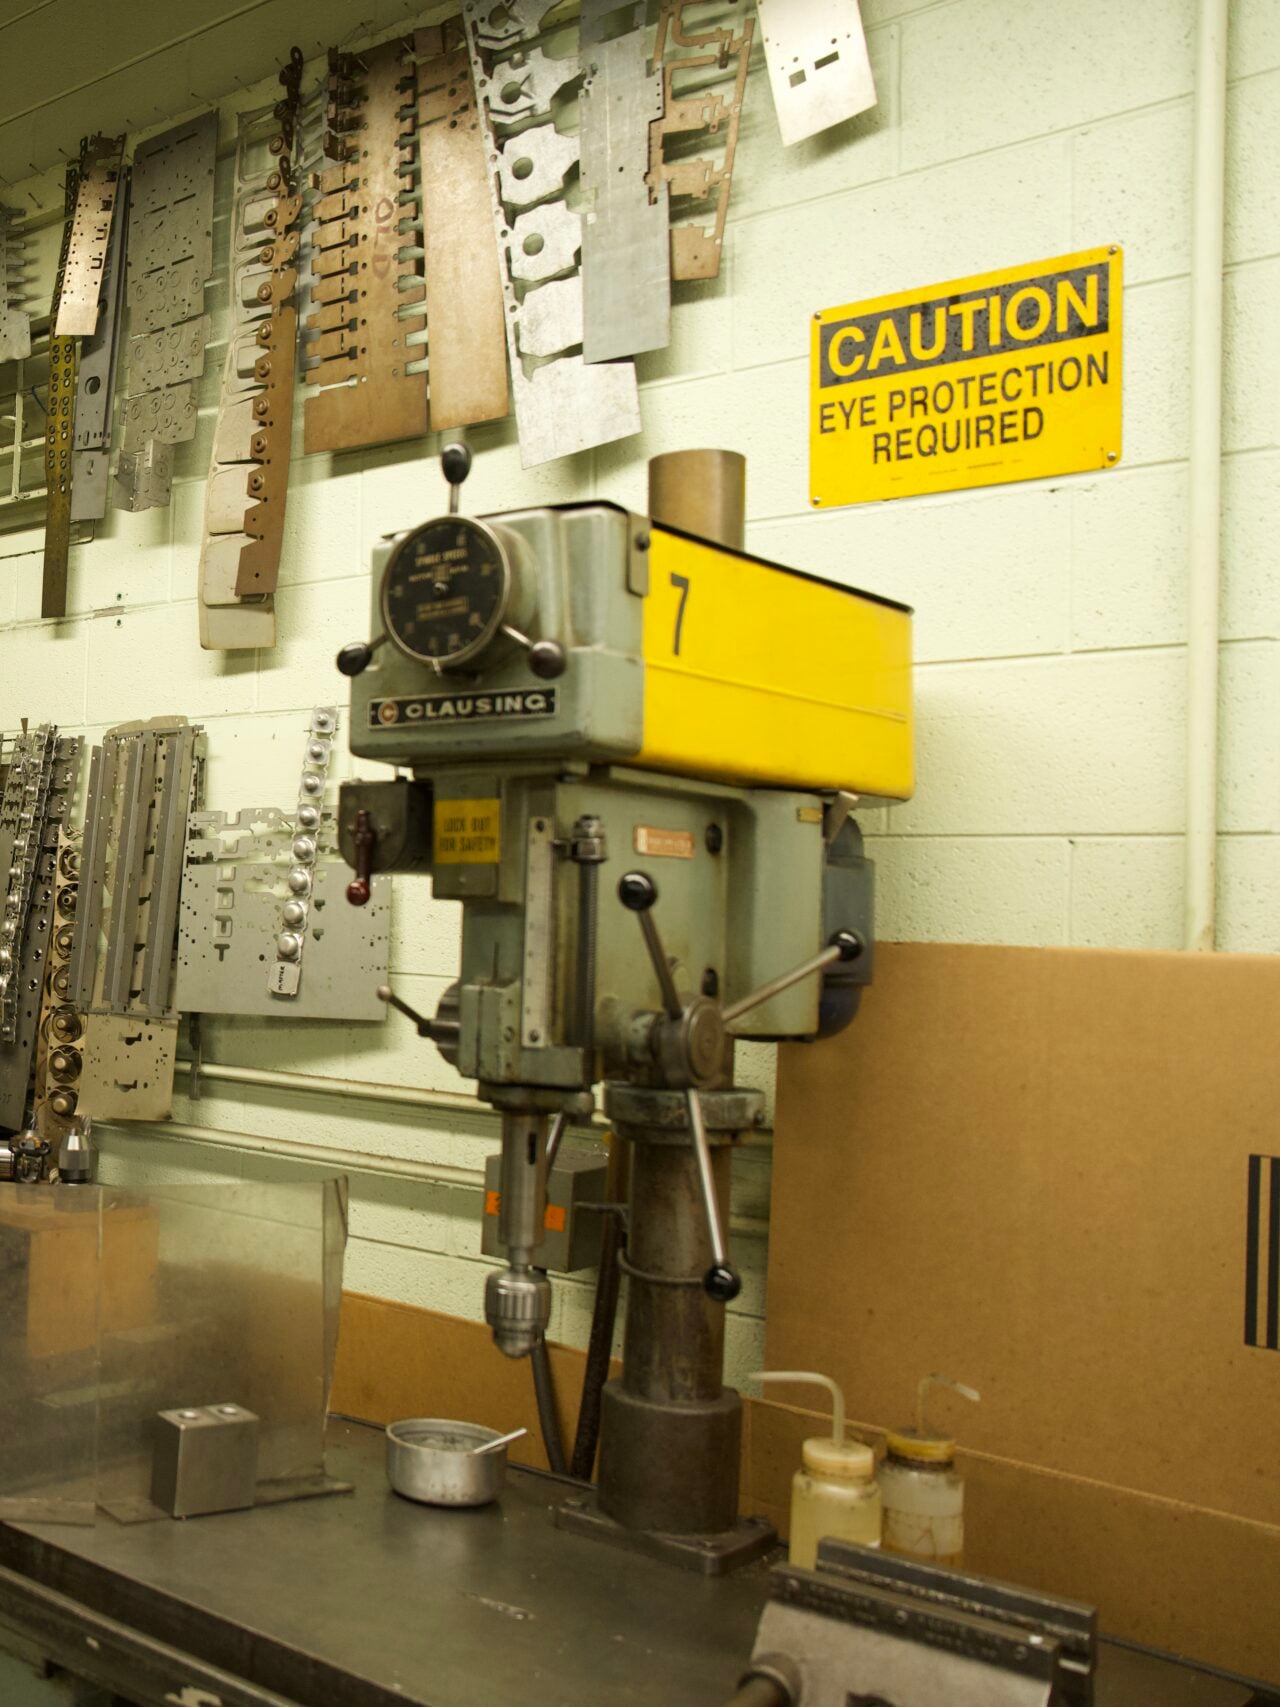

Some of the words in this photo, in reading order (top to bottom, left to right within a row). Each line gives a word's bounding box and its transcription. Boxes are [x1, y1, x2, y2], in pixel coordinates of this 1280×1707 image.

[828, 274, 1099, 377] CAUTION
[820, 394, 877, 434] EYE
[889, 351, 1109, 422] PROTECTION
[873, 406, 1044, 464] REQUIRED
[670, 573, 690, 655] 7
[405, 694, 547, 718] CLAUSING
[439, 837, 455, 851] FOR
[460, 836, 496, 852] SAFETY
[444, 817, 465, 832] LOCK
[471, 817, 490, 832] OUT
